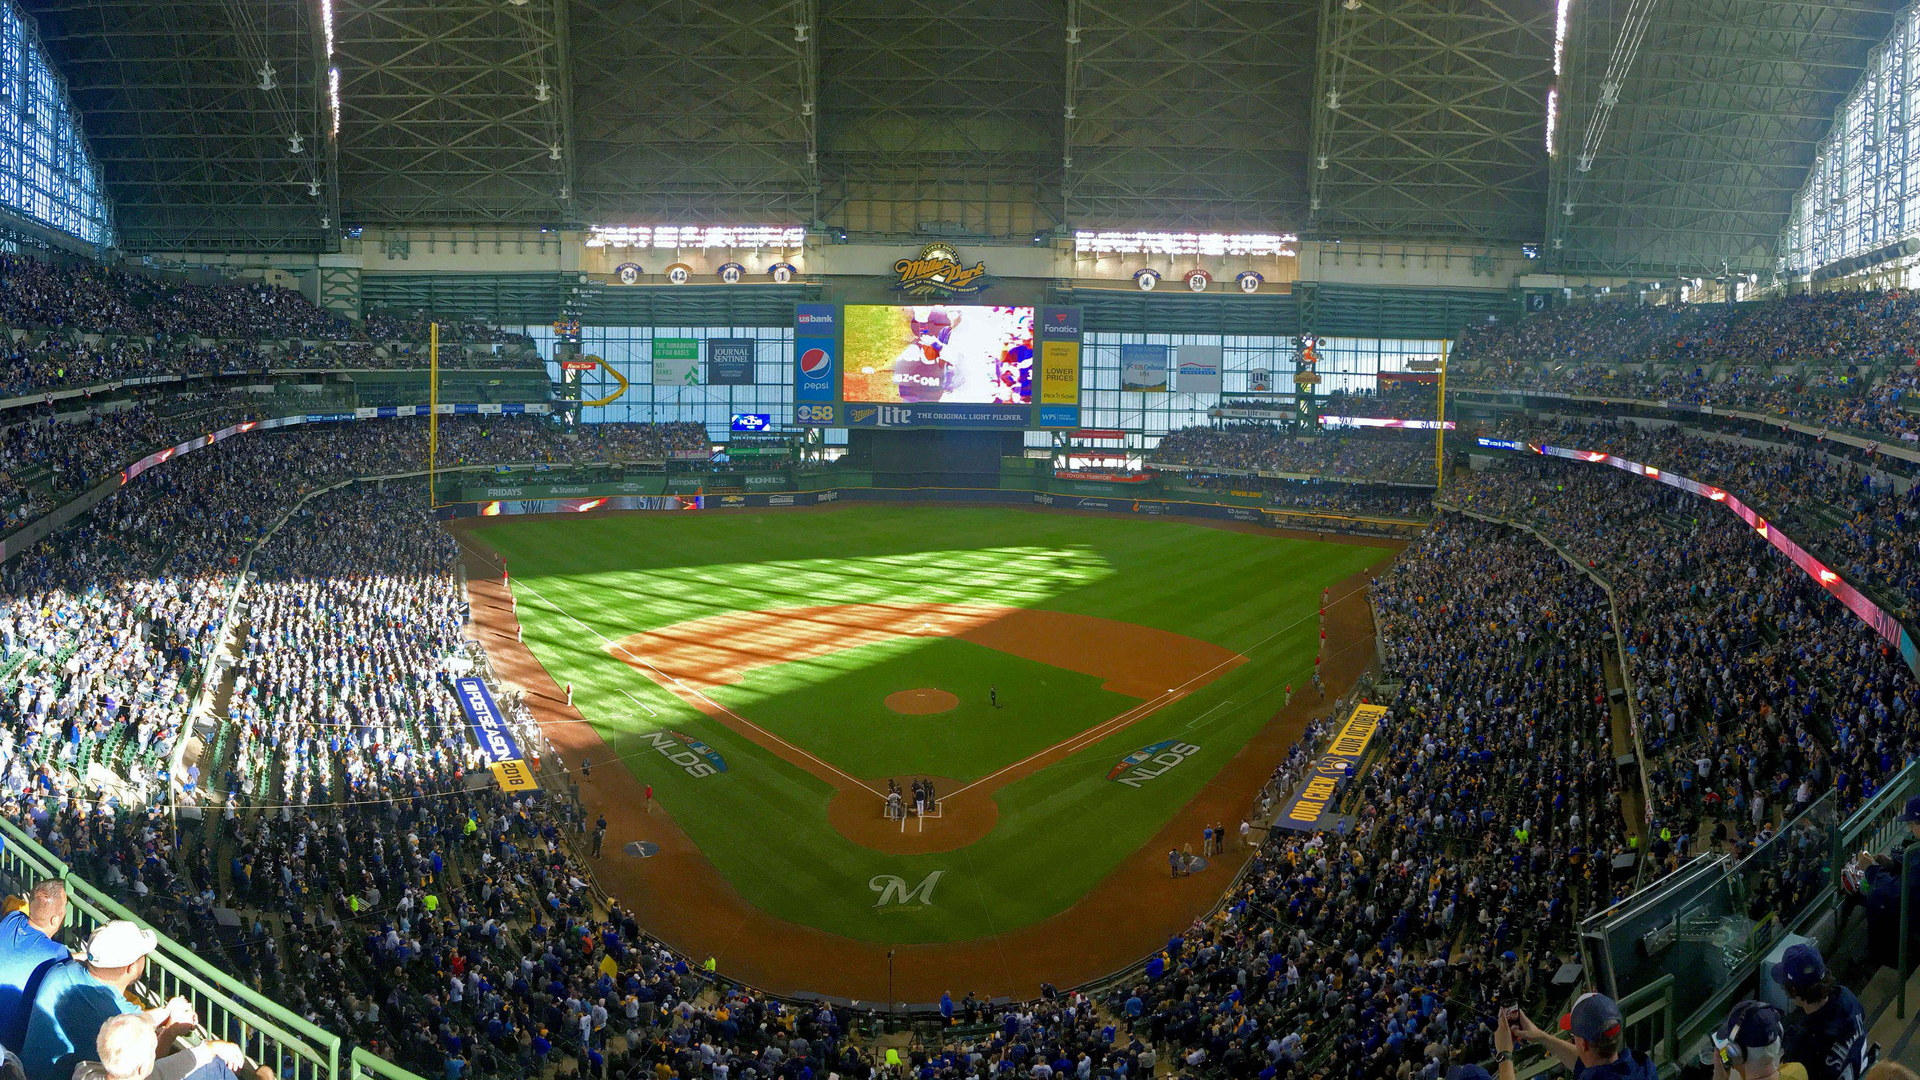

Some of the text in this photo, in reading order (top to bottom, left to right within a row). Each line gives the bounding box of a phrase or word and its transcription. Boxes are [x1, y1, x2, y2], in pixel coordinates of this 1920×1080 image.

[623, 271, 635, 280] 34
[672, 271, 685, 280] 42
[725, 271, 738, 280] 44
[894, 257, 985, 285] Miller Park
[932, 281, 957, 291] MILWAUKEE
[1143, 277, 1149, 287] 4
[1192, 277, 1204, 285] 50
[1244, 279, 1256, 289] 19
[1045, 324, 1077, 333] Fanatics
[714, 348, 749, 356] JOURNAL
[1252, 372, 1268, 383] Lite
[804, 382, 829, 390] pepsi
[811, 406, 833, 420] 58
[850, 408, 877, 422] Miller
[876, 405, 912, 426] Lite
[488, 488, 522, 497] FRIDAYS
[818, 490, 837, 501] meijer
[1231, 490, 1262, 498] UWM.EDU
[1034, 494, 1053, 504] meijer
[467, 691, 514, 761] POSTSEASON
[1335, 737, 1364, 752] OUR
[640, 732, 717, 778] NLDS
[1117, 743, 1201, 788] NLDS
[501, 762, 524, 786] 2018
[1289, 800, 1325, 822] OUR
[868, 870, 949, 907] M
